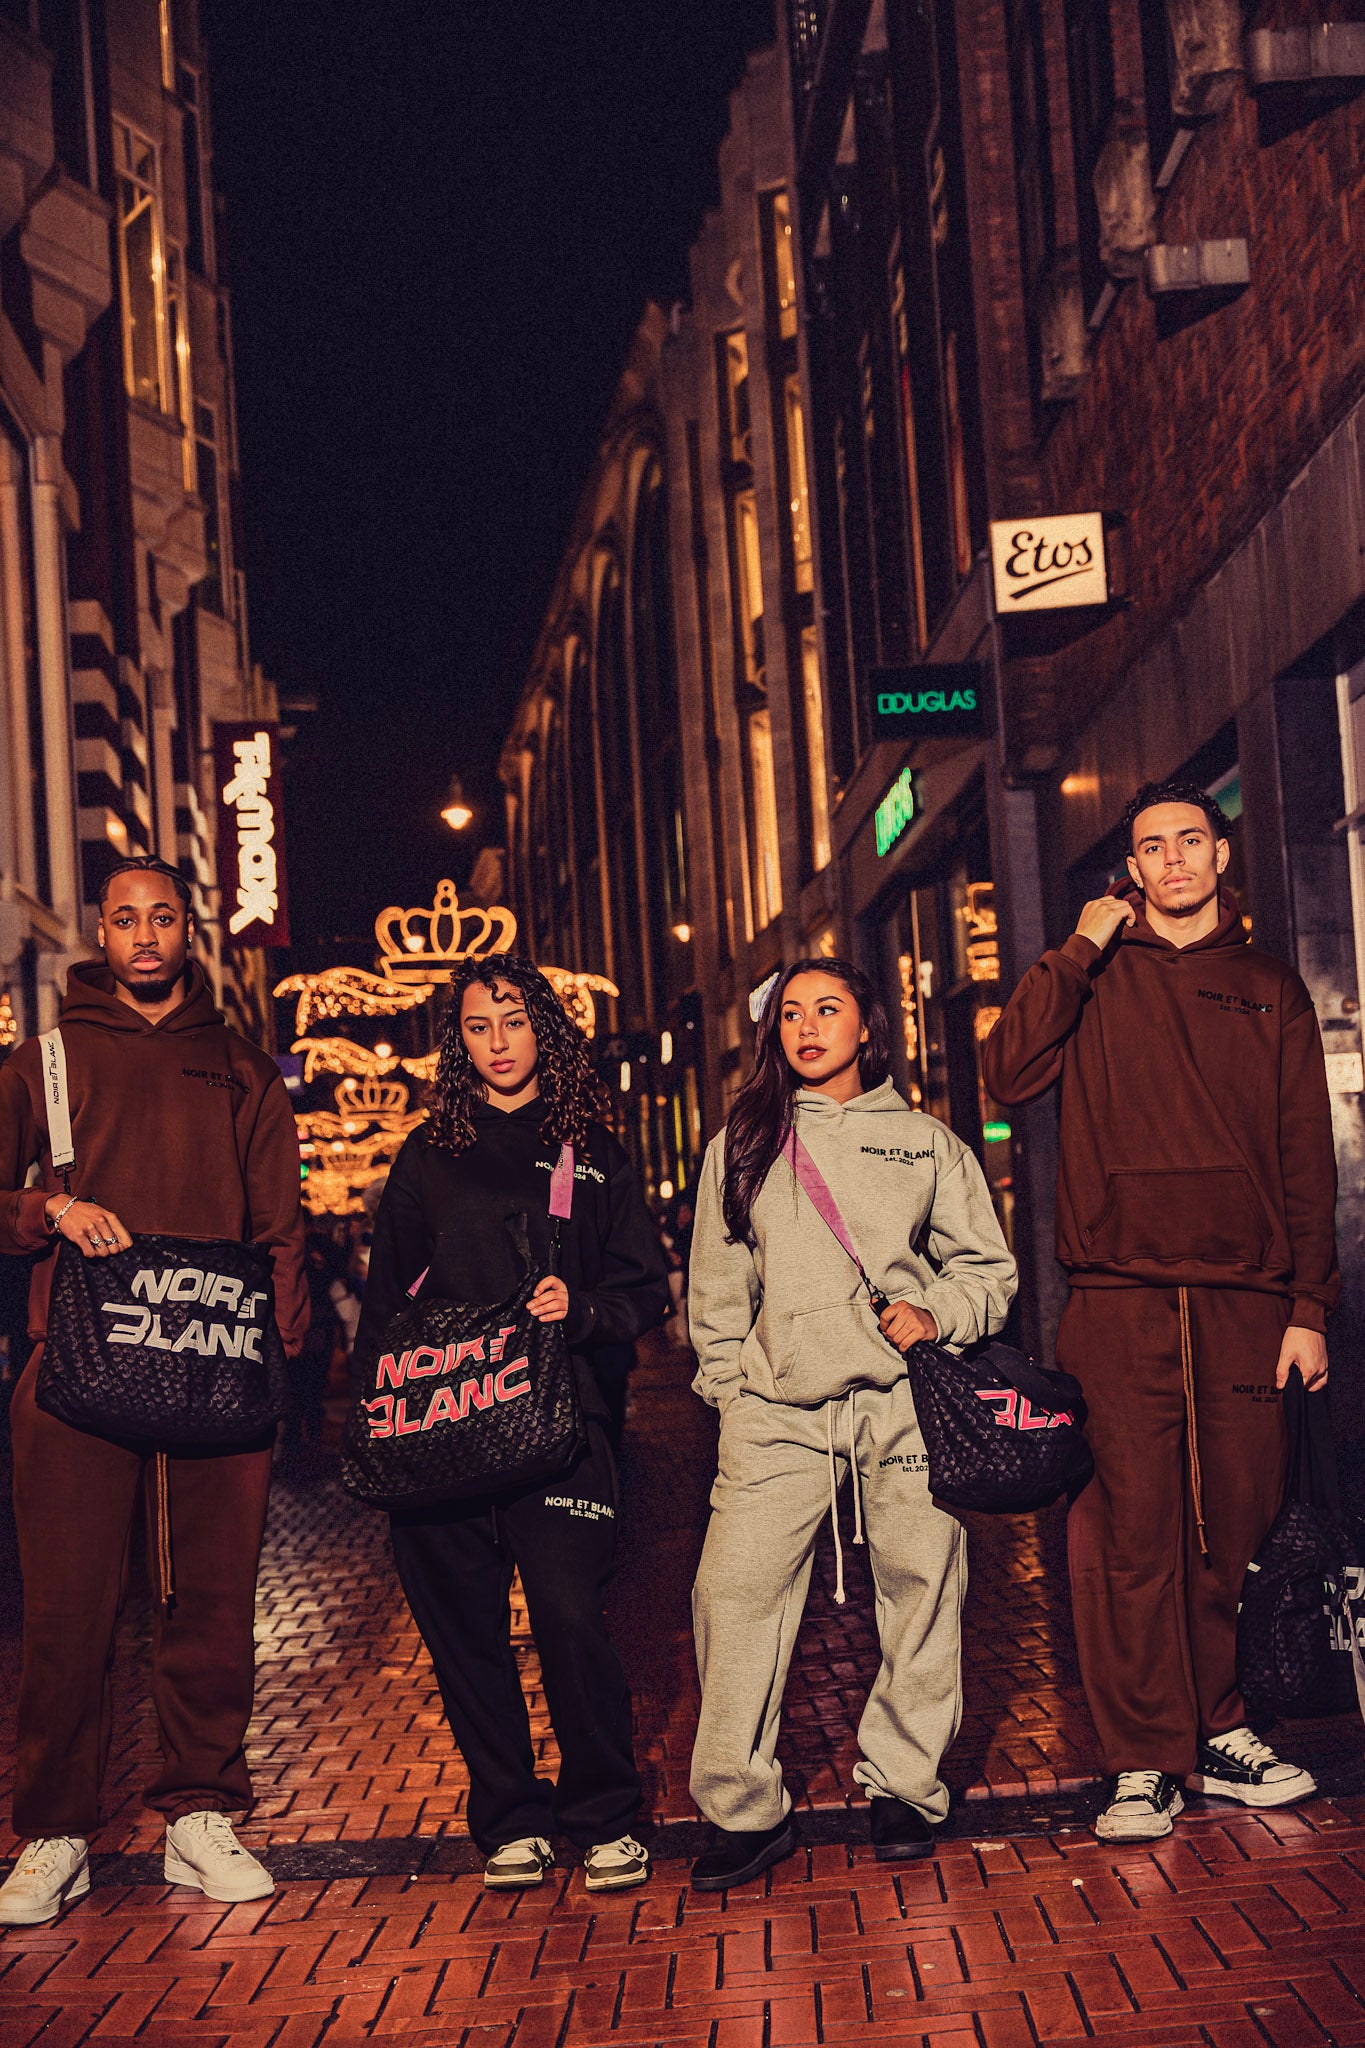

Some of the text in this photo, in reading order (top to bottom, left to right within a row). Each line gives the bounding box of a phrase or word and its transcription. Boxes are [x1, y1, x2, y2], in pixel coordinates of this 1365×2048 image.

[1006, 531, 1092, 578] Etos
[877, 689, 977, 714] DOUGLAS
[1197, 989, 1273, 1013] NOIR ET BLANC
[48, 1041, 57, 1068] BLANC
[183, 1069, 207, 1078] NOIR
[211, 1072, 222, 1080] ET
[860, 1146, 886, 1156] NOIR
[890, 1148, 901, 1156] ET
[899, 1158, 914, 1167] 2024
[574, 1173, 587, 1181] 024
[575, 1165, 606, 1184] BLANC
[131, 1268, 267, 1319] NOIR ET
[101, 1302, 263, 1364] BLANC
[376, 1325, 517, 1389] NOIR ET
[361, 1356, 531, 1438] BLANC
[1232, 1384, 1254, 1394] NOIR
[1258, 1386, 1268, 1394] ET
[879, 1455, 903, 1468] NOIR
[906, 1455, 917, 1464] ET
[545, 1496, 574, 1507] NOIR
[577, 1499, 589, 1510] ET
[570, 1508, 599, 1520] Est. 2024
